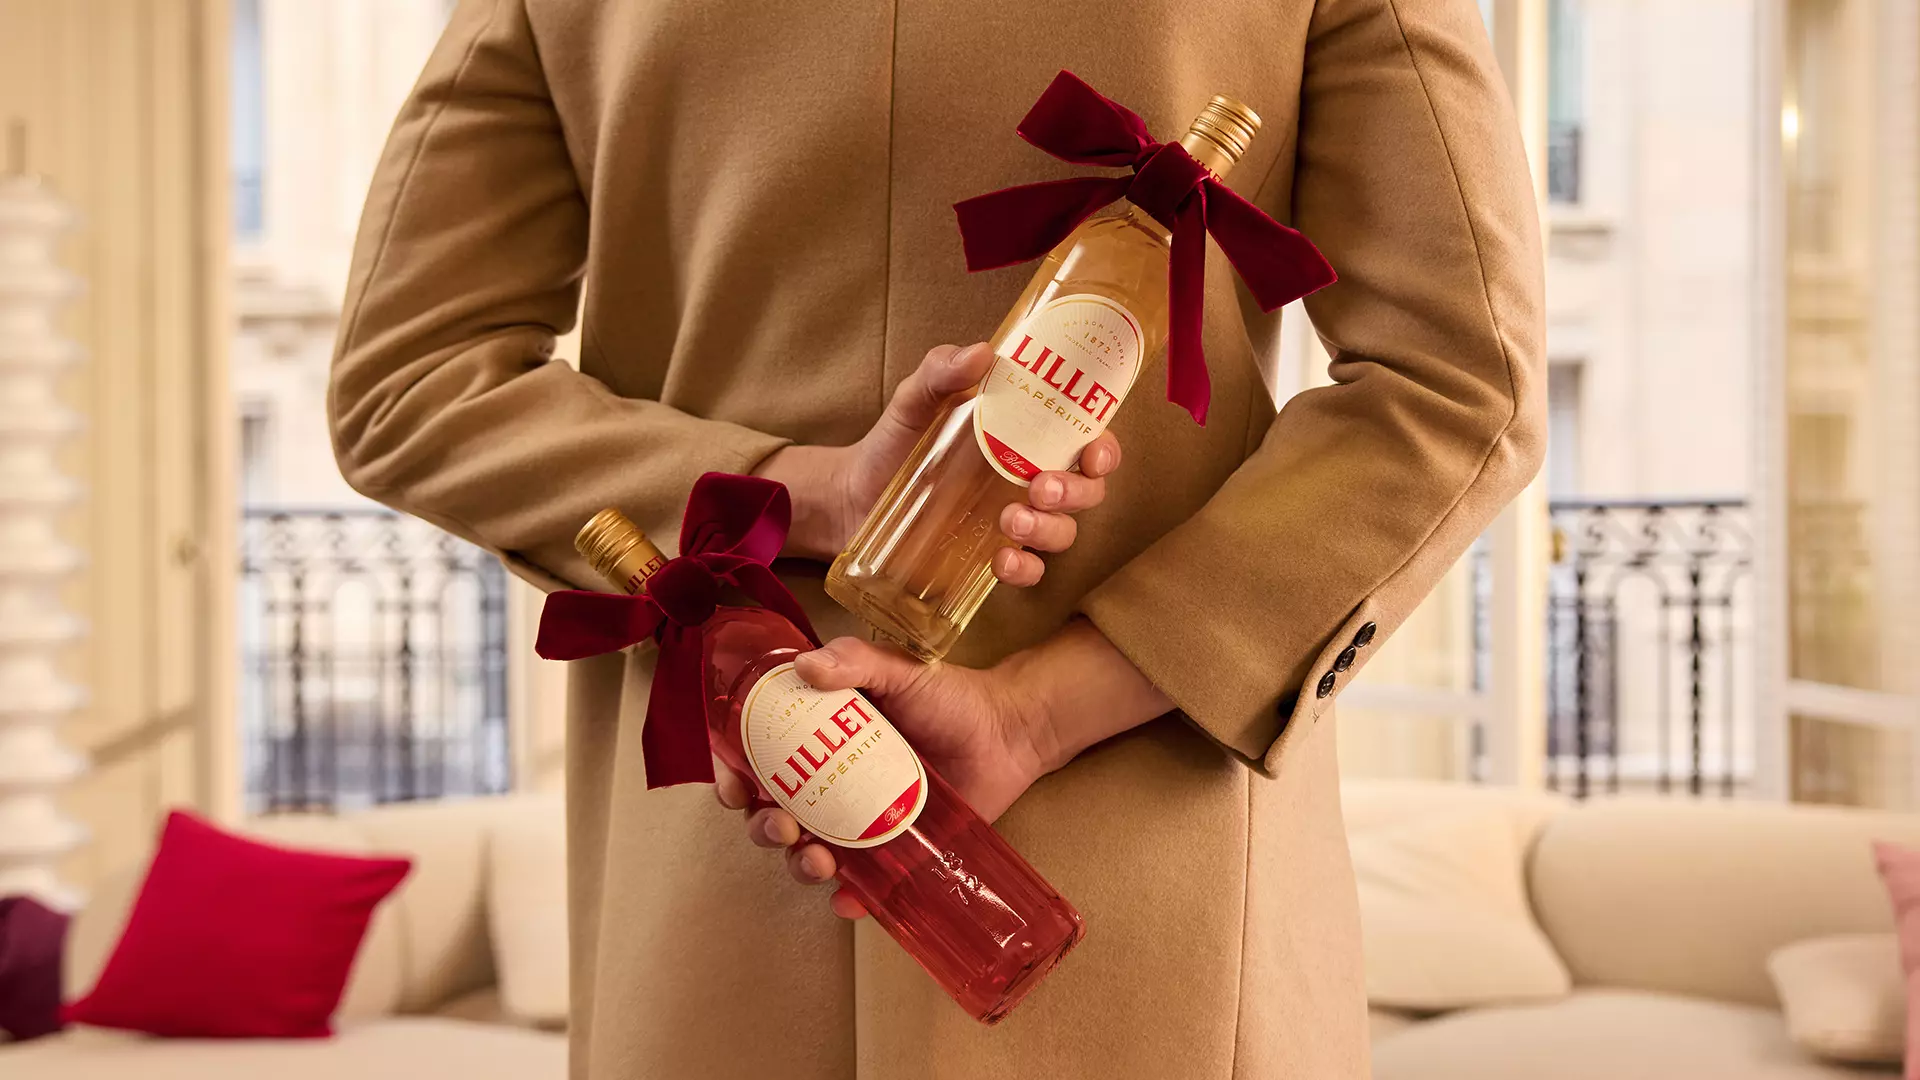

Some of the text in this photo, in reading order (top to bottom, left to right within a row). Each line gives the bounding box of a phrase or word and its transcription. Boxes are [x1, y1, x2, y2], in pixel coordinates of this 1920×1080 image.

[1083, 331, 1111, 355] 1872
[1006, 372, 1092, 435] L'APÉRITIF
[1010, 334, 1119, 423] LILLET
[623, 555, 664, 596] LILLET
[779, 697, 805, 722] 1872
[770, 697, 874, 800] LILLET
[805, 729, 883, 807] L'APÉRITIF
